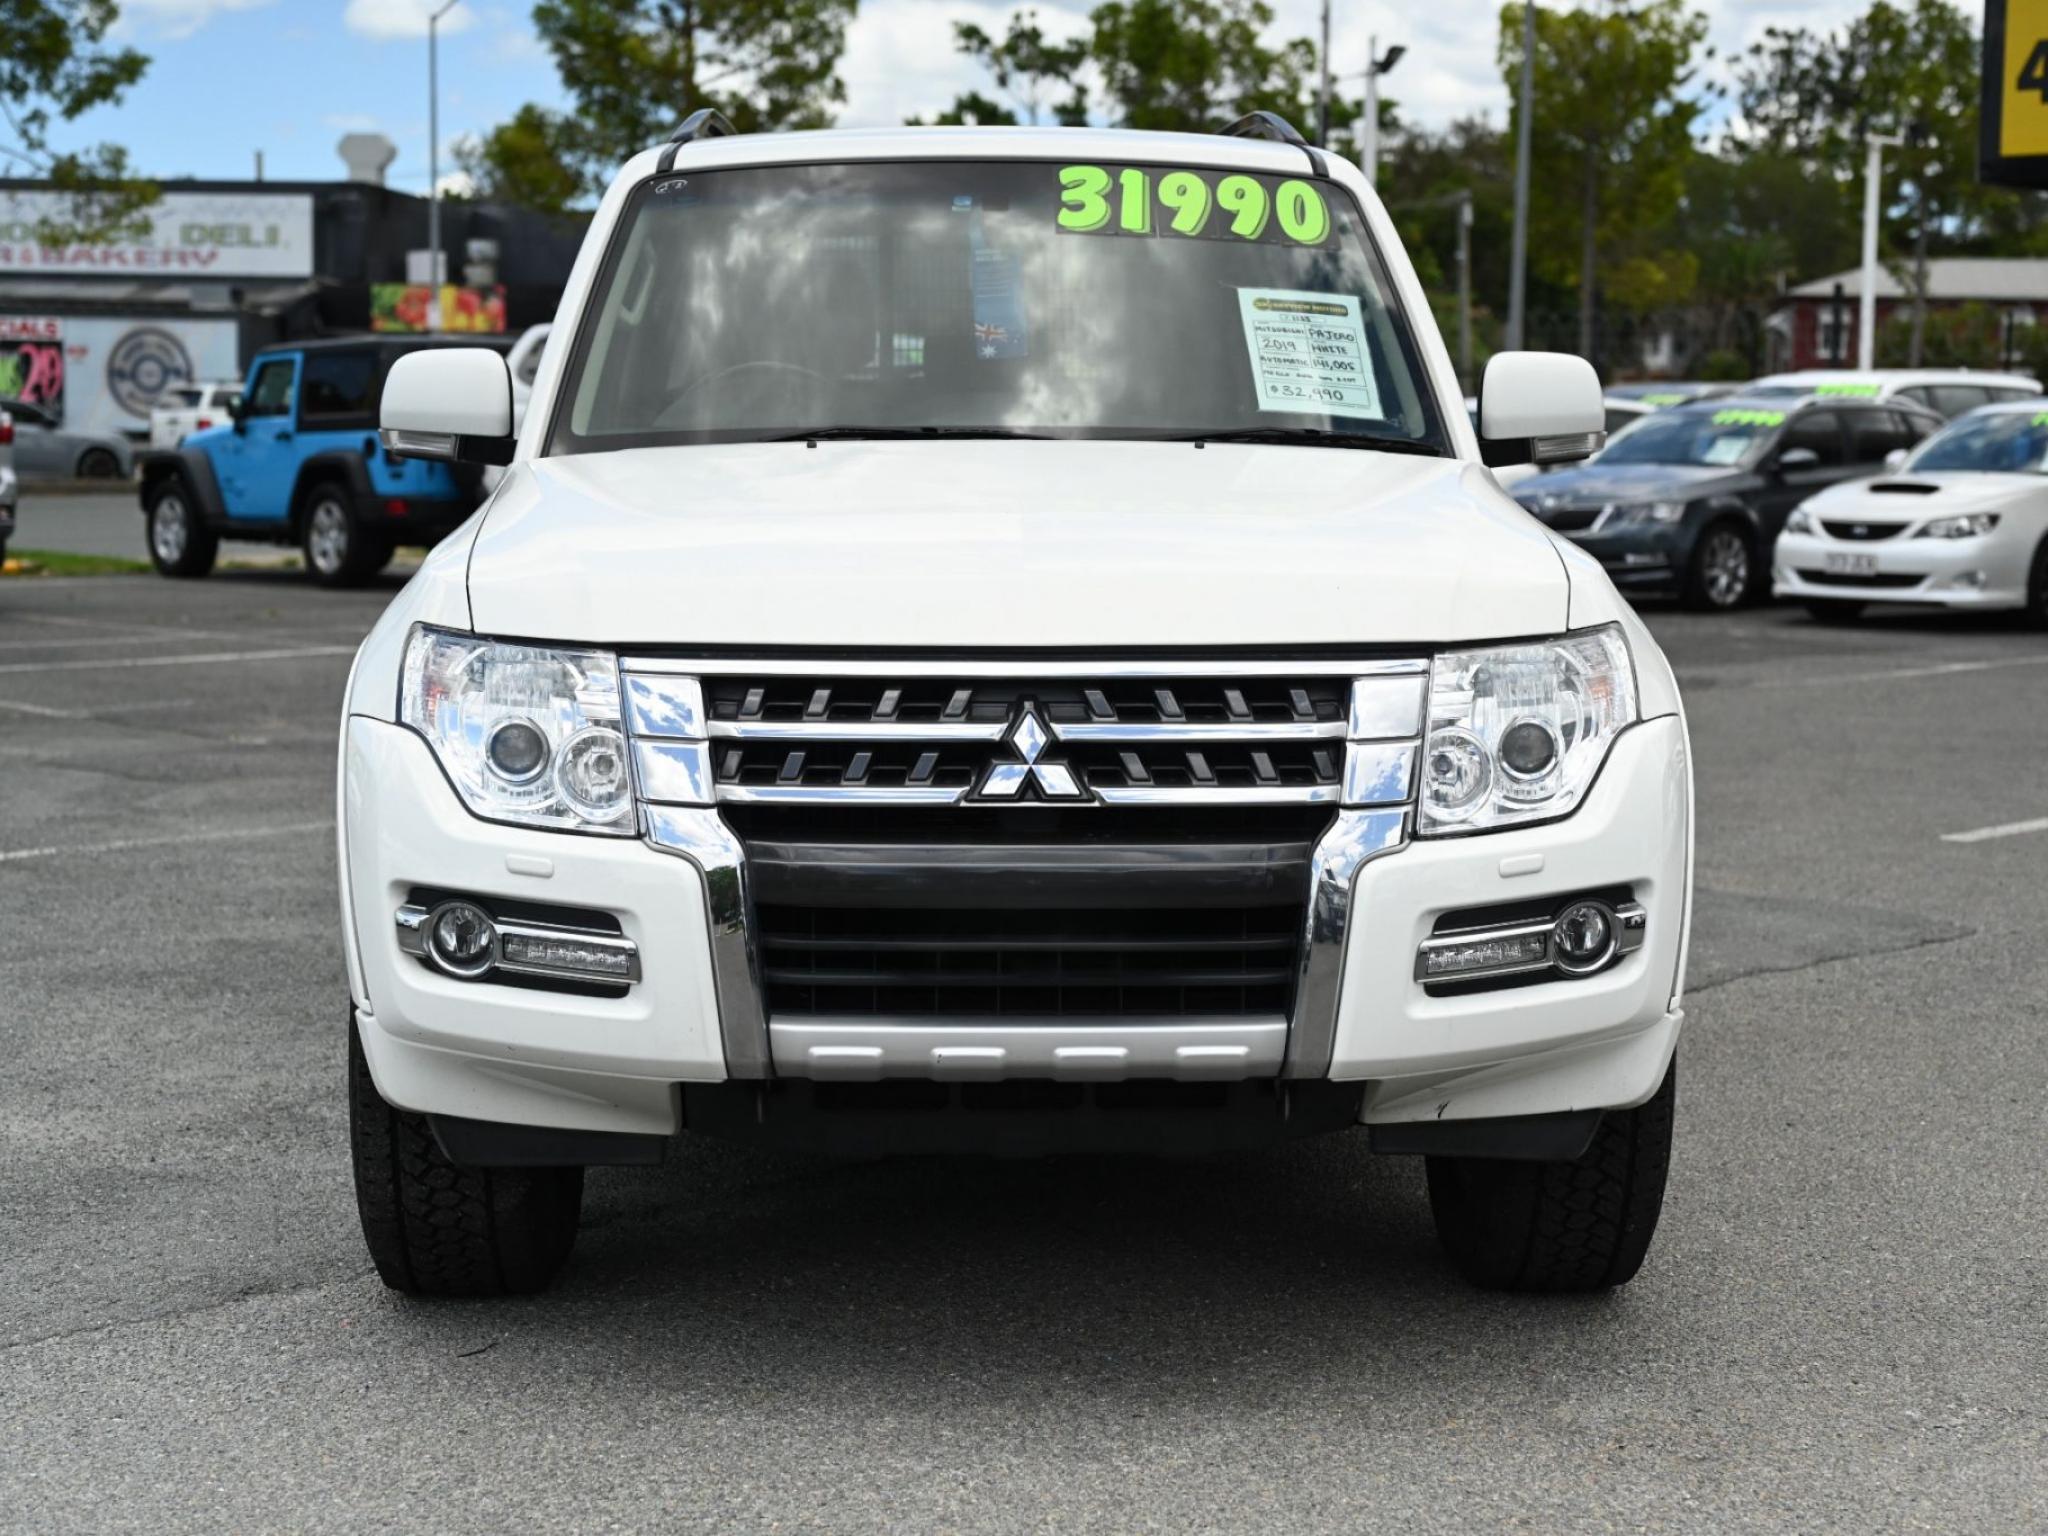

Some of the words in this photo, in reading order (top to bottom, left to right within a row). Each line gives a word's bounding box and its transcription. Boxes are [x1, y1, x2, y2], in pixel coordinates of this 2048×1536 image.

[1057, 165, 1331, 246] 31990
[179, 223, 281, 247] DELI
[39, 248, 221, 269] BAKERY
[1262, 338, 1297, 351] 2019
[1308, 328, 1355, 342] PAJERO
